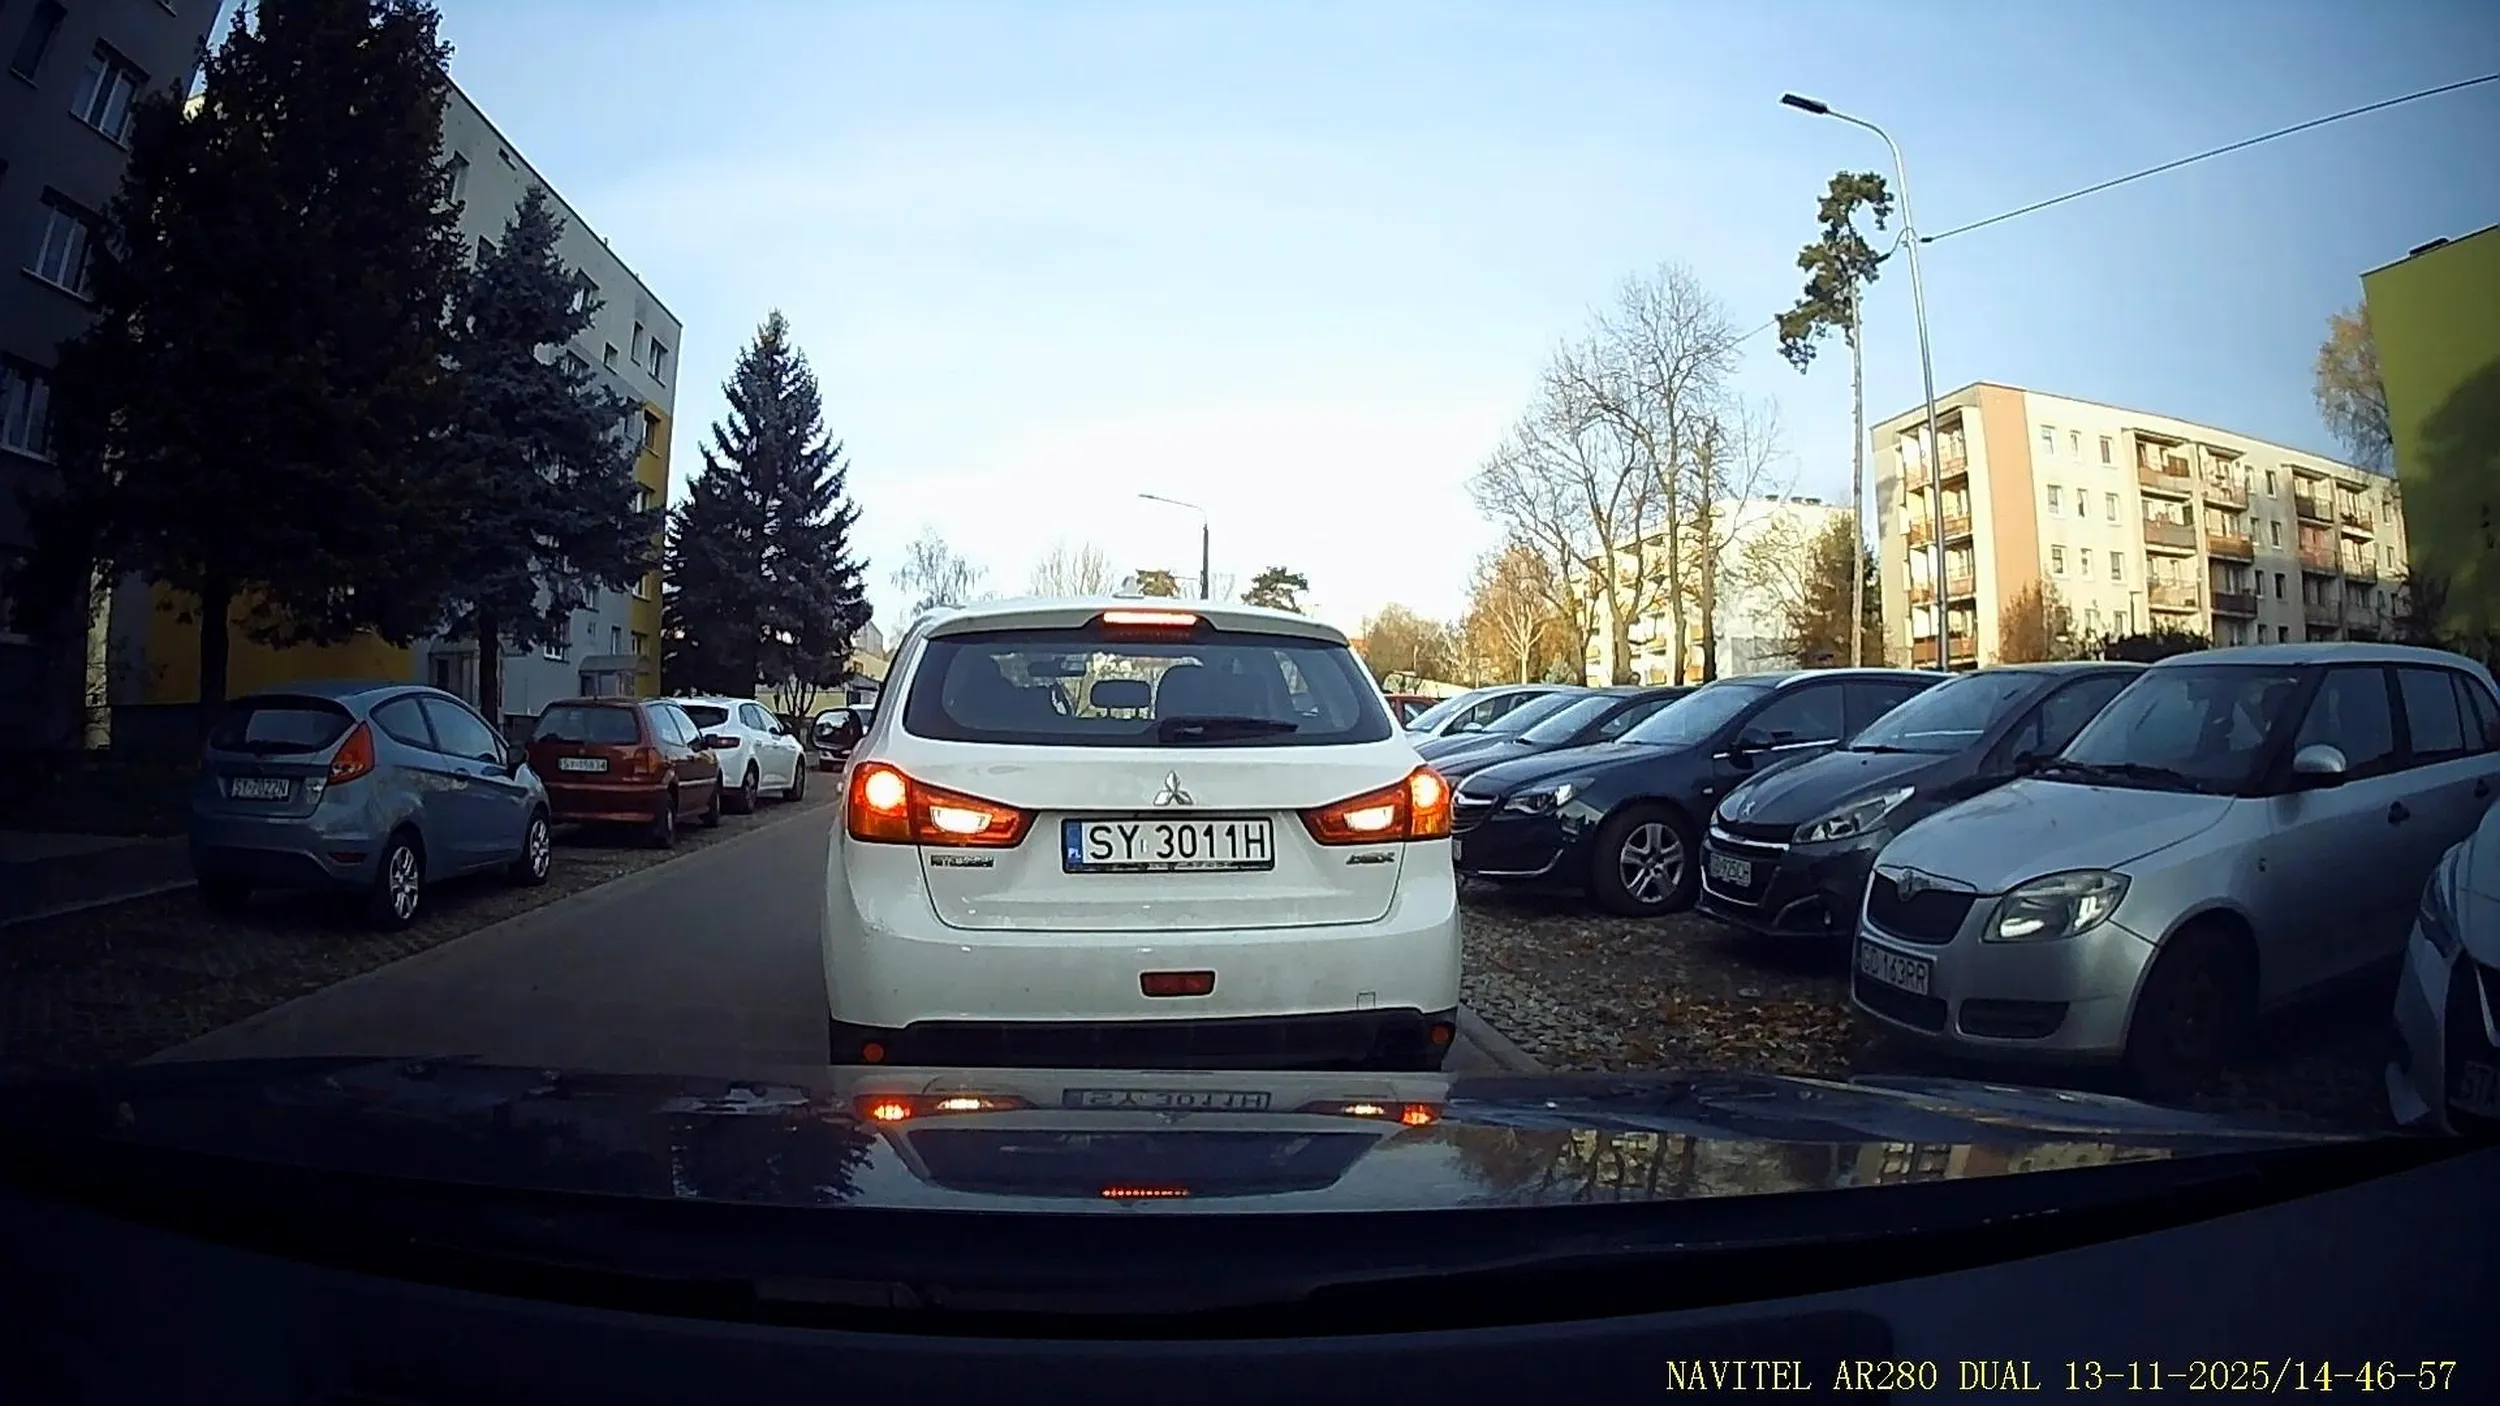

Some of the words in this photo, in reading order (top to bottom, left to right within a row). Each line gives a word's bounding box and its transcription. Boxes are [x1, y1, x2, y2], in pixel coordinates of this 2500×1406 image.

[1067, 847, 1082, 859] PL
[1089, 824, 1140, 860] SY
[1155, 824, 1266, 859] 3011H
